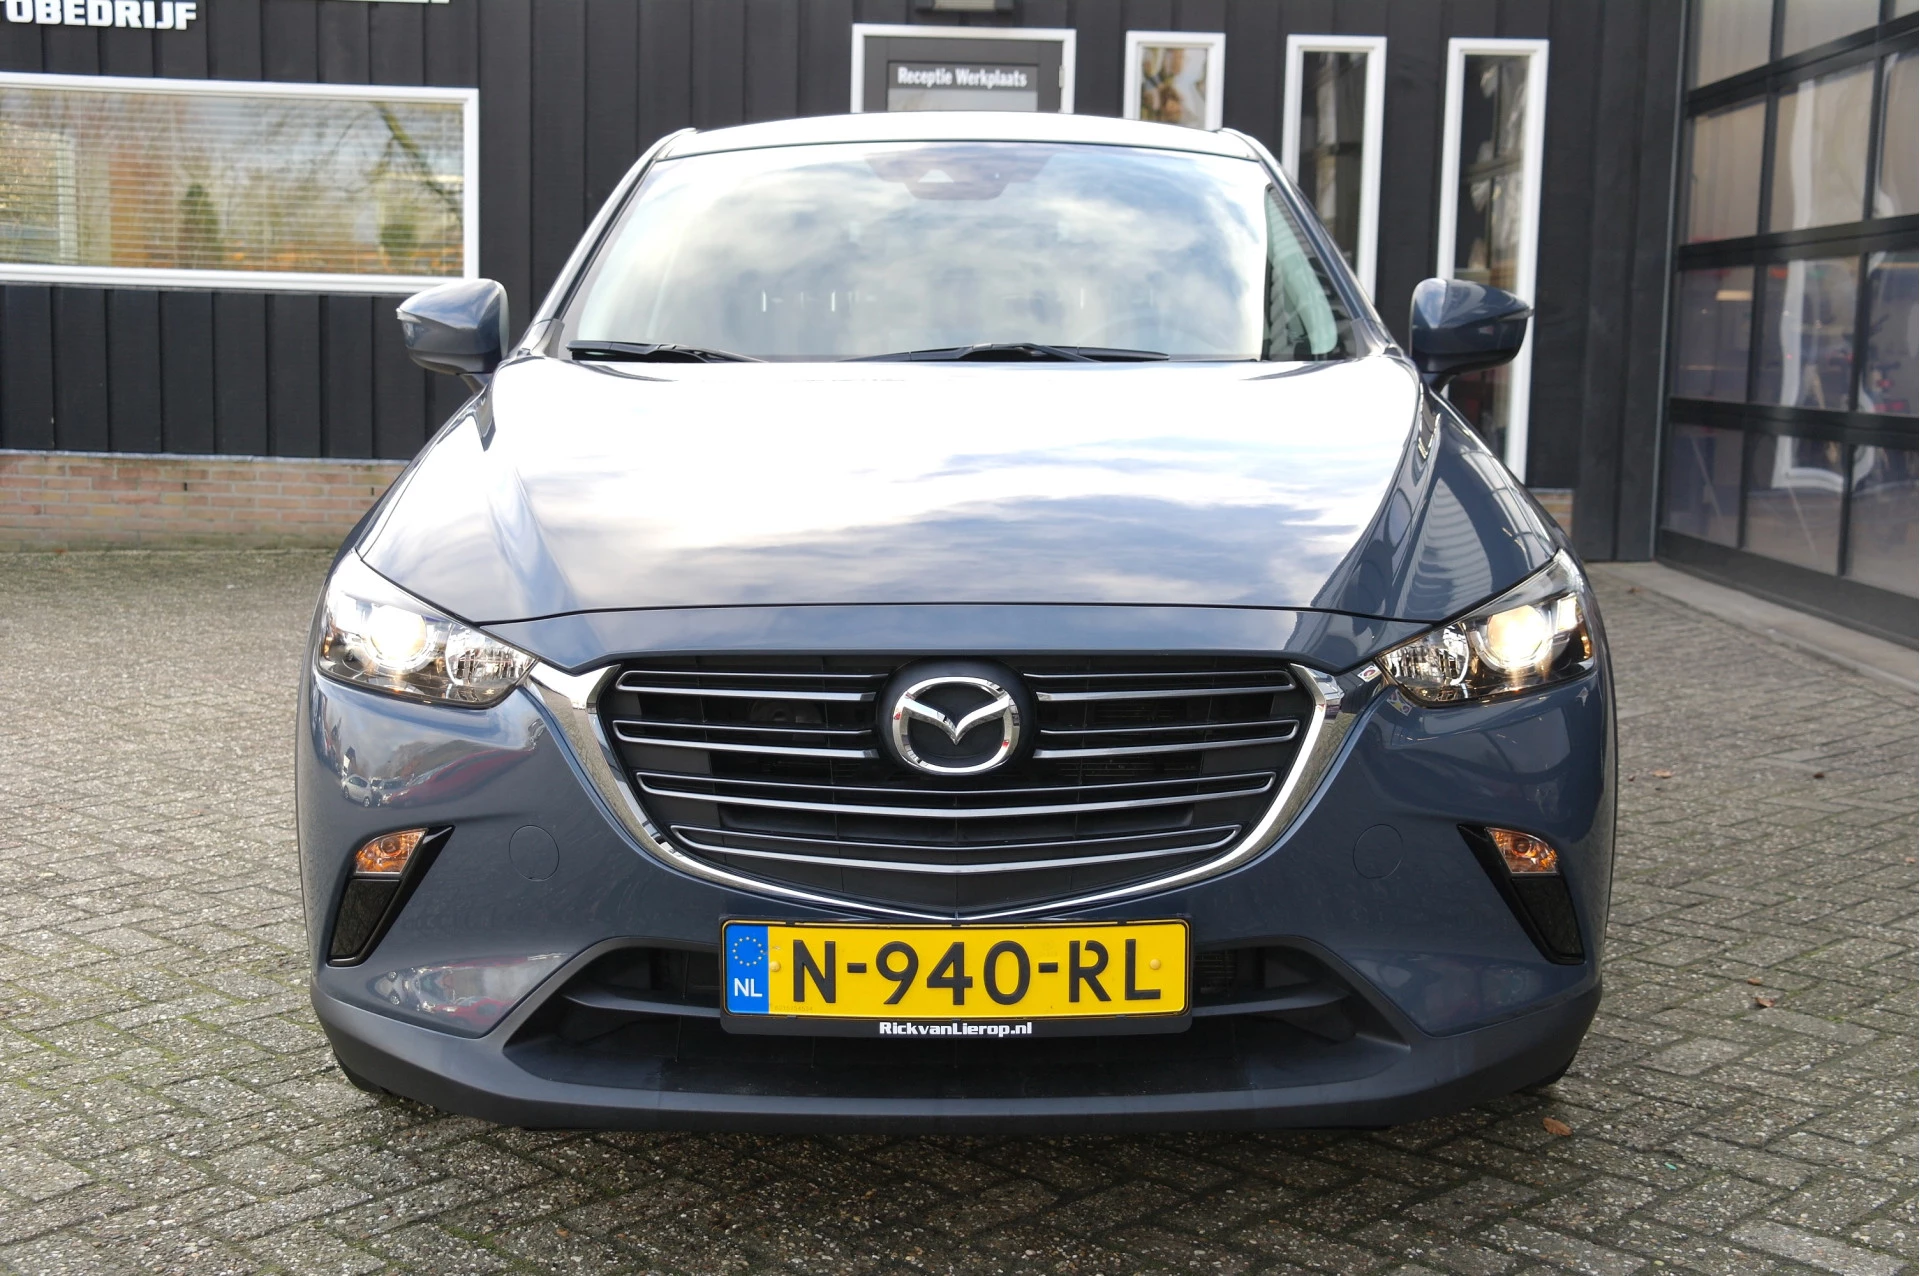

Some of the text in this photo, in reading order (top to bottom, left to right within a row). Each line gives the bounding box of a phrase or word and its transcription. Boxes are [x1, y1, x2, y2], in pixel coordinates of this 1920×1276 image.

[0, 0, 197, 31] OBEDRIJF
[898, 66, 1028, 89] Receptie Werkplaats
[792, 938, 1162, 1005] N-940-RL
[734, 977, 763, 997] NL
[879, 1021, 1033, 1037] RickvanLierop.nl
